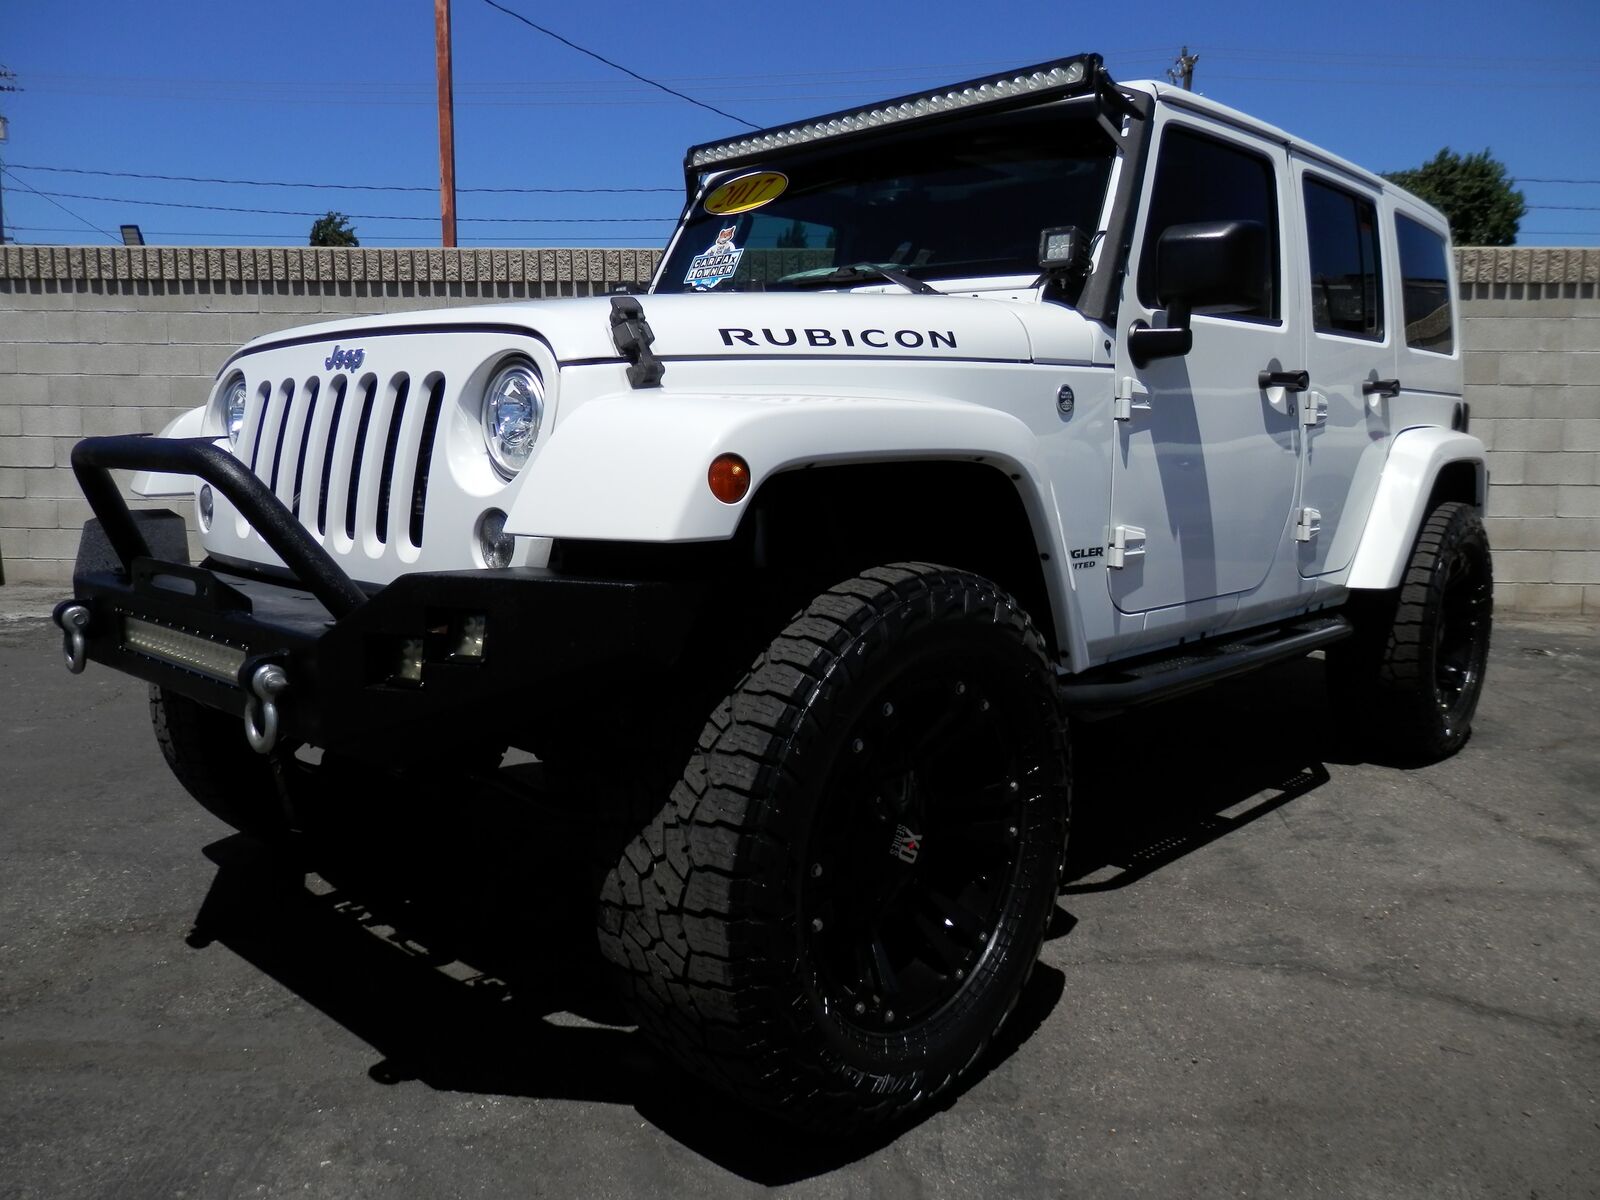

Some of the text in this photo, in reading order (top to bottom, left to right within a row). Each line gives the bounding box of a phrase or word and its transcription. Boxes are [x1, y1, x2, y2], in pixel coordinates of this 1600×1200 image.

[713, 177, 778, 209] 2017
[694, 253, 738, 268] CARFAX
[718, 328, 957, 348] RUBICON
[324, 344, 366, 374] Jeep
[1073, 561, 1096, 570] ITED
